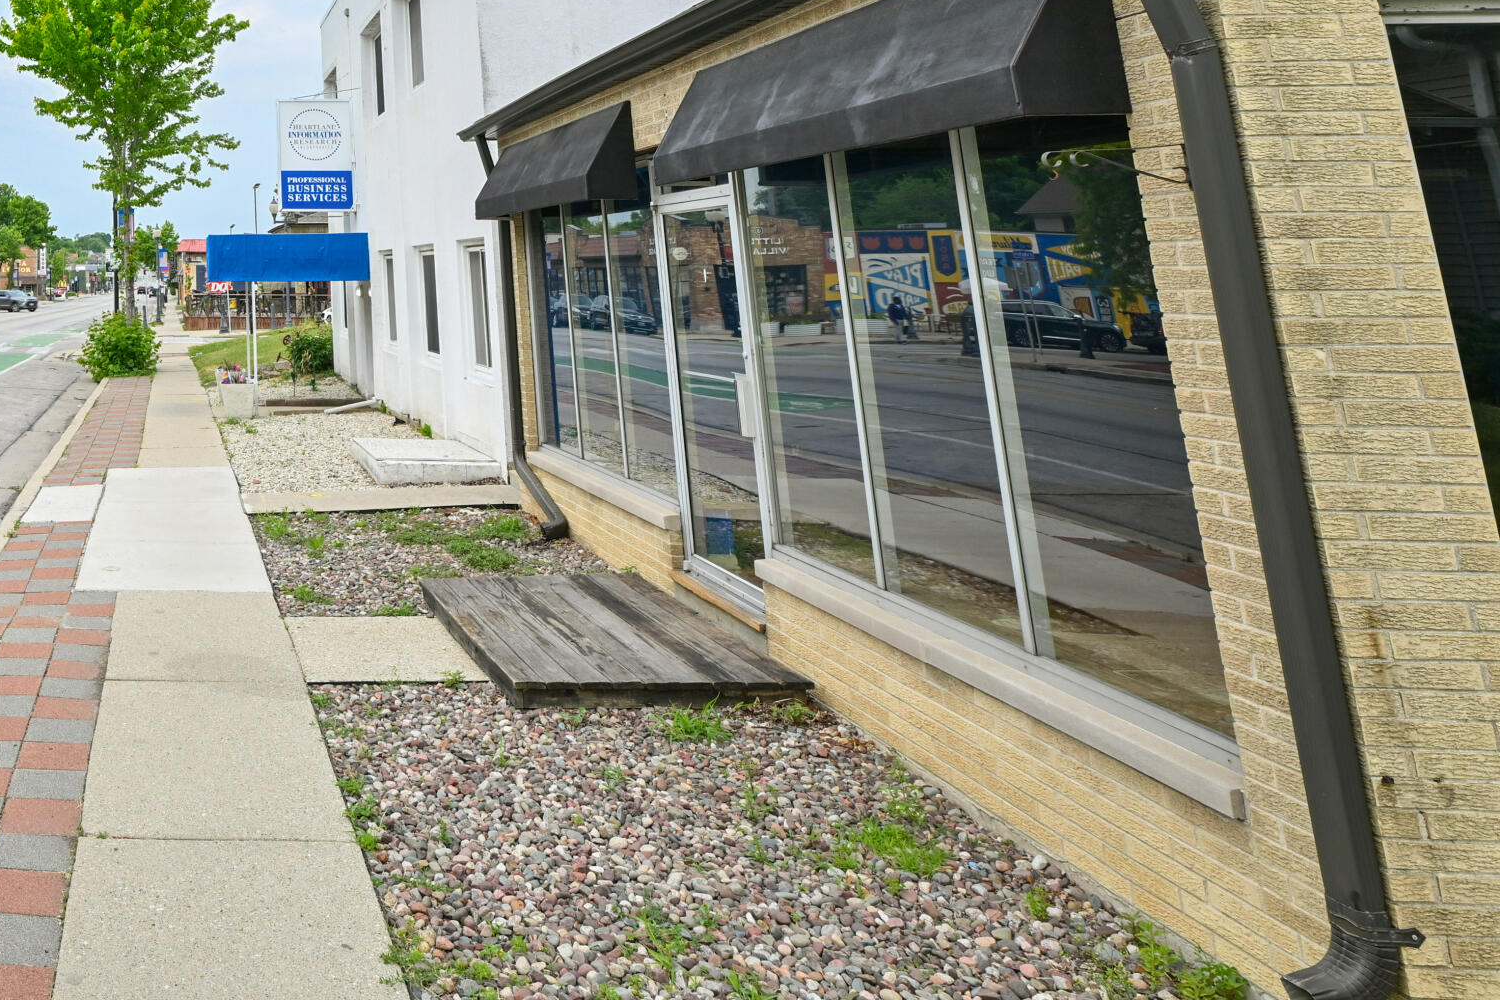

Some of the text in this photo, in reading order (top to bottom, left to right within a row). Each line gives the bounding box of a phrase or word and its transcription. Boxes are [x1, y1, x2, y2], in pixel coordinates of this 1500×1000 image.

[287, 184, 347, 193] BUSINESS
[287, 193, 348, 202] SERVICES
[211, 282, 229, 292] DQ
